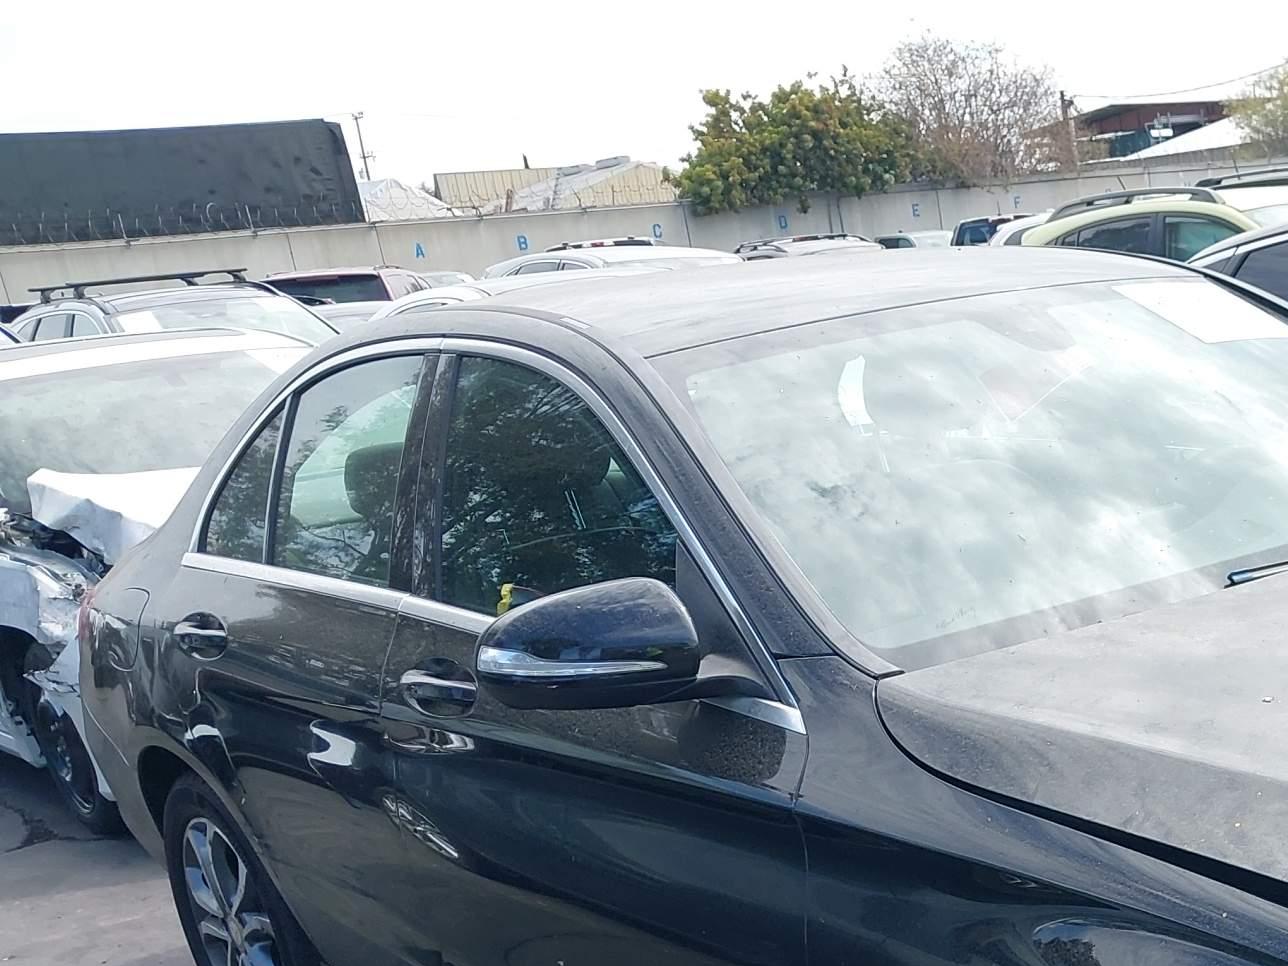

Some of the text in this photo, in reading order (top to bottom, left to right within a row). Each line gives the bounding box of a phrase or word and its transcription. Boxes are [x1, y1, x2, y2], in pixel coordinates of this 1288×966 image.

[1014, 195, 1022, 209] F
[911, 203, 920, 218] E
[778, 214, 788, 230] D
[653, 223, 662, 239] C
[415, 243, 425, 259] A
[516, 235, 529, 251] B
